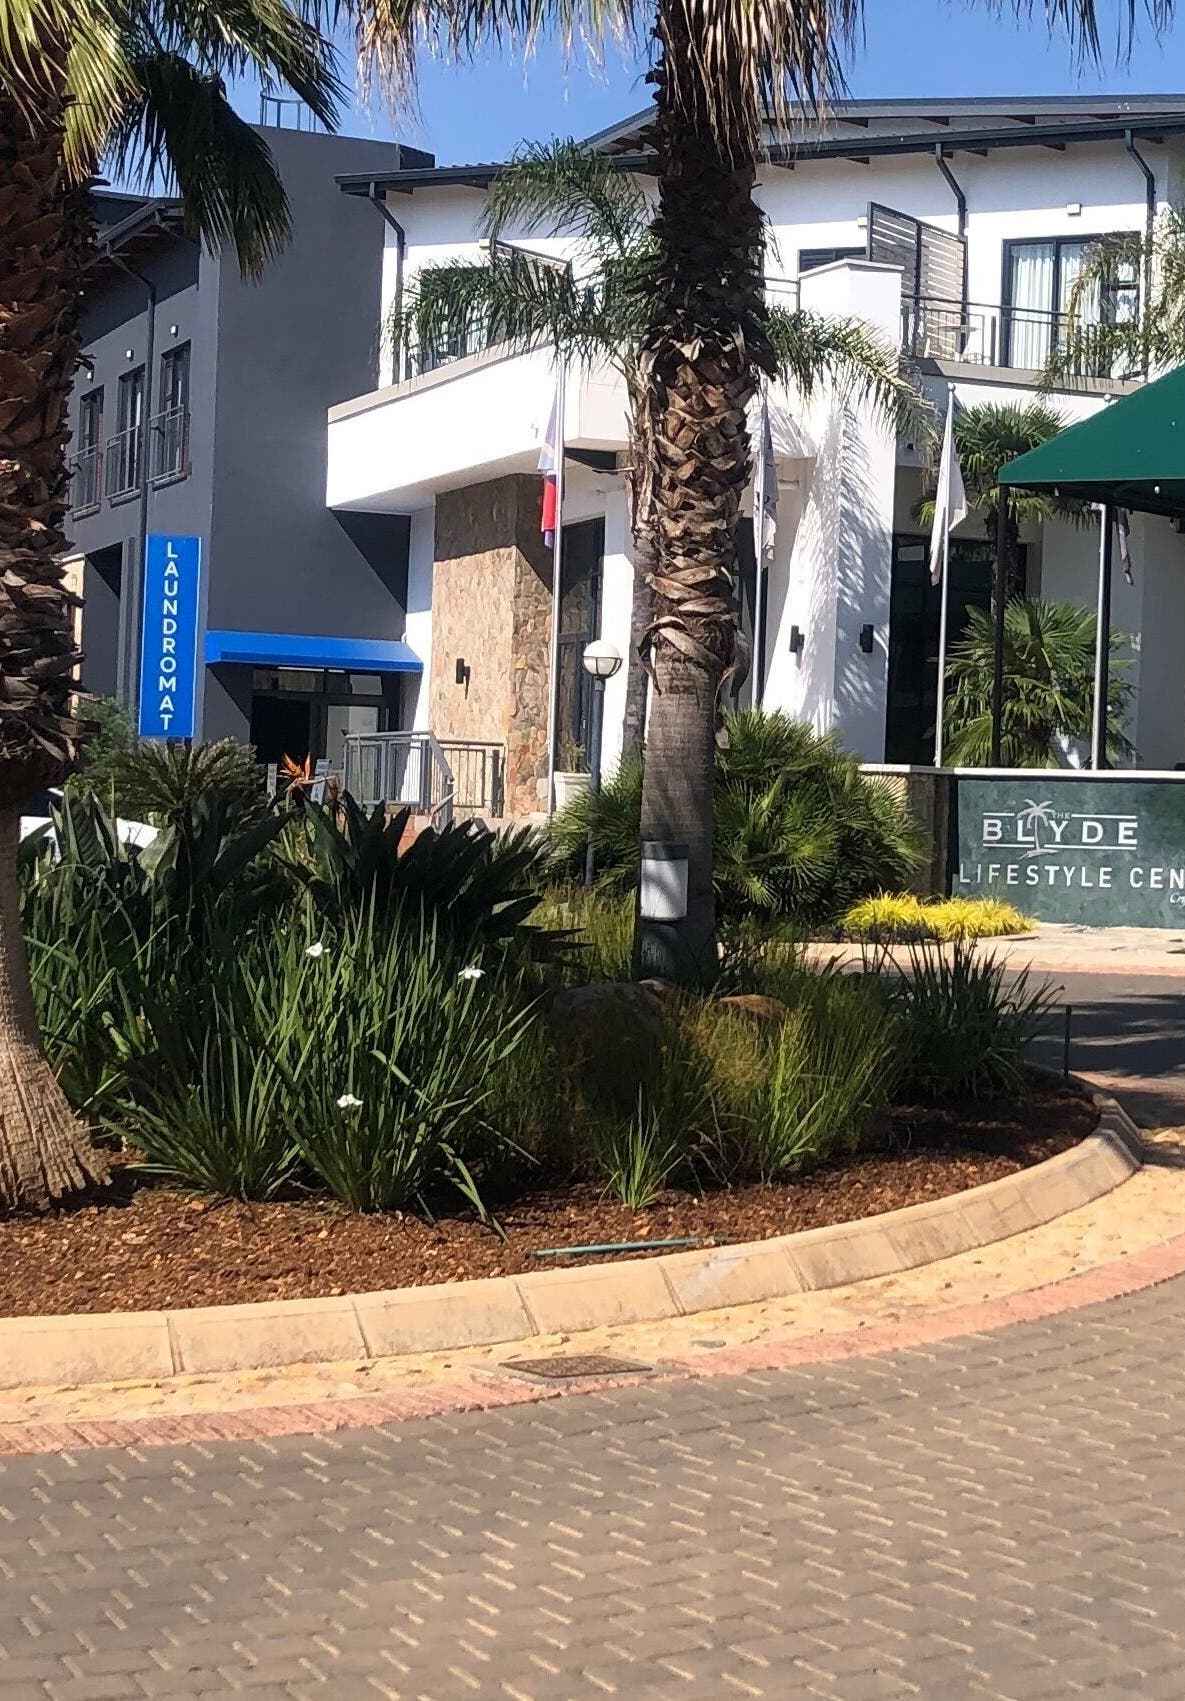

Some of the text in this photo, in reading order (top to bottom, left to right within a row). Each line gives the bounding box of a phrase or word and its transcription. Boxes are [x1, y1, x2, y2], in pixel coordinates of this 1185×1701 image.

[159, 541, 179, 730] LAUNDROMAT
[1051, 811, 1072, 820] THE
[982, 819, 1138, 845] BLYDE
[959, 863, 1113, 888] LIFESTYLE
